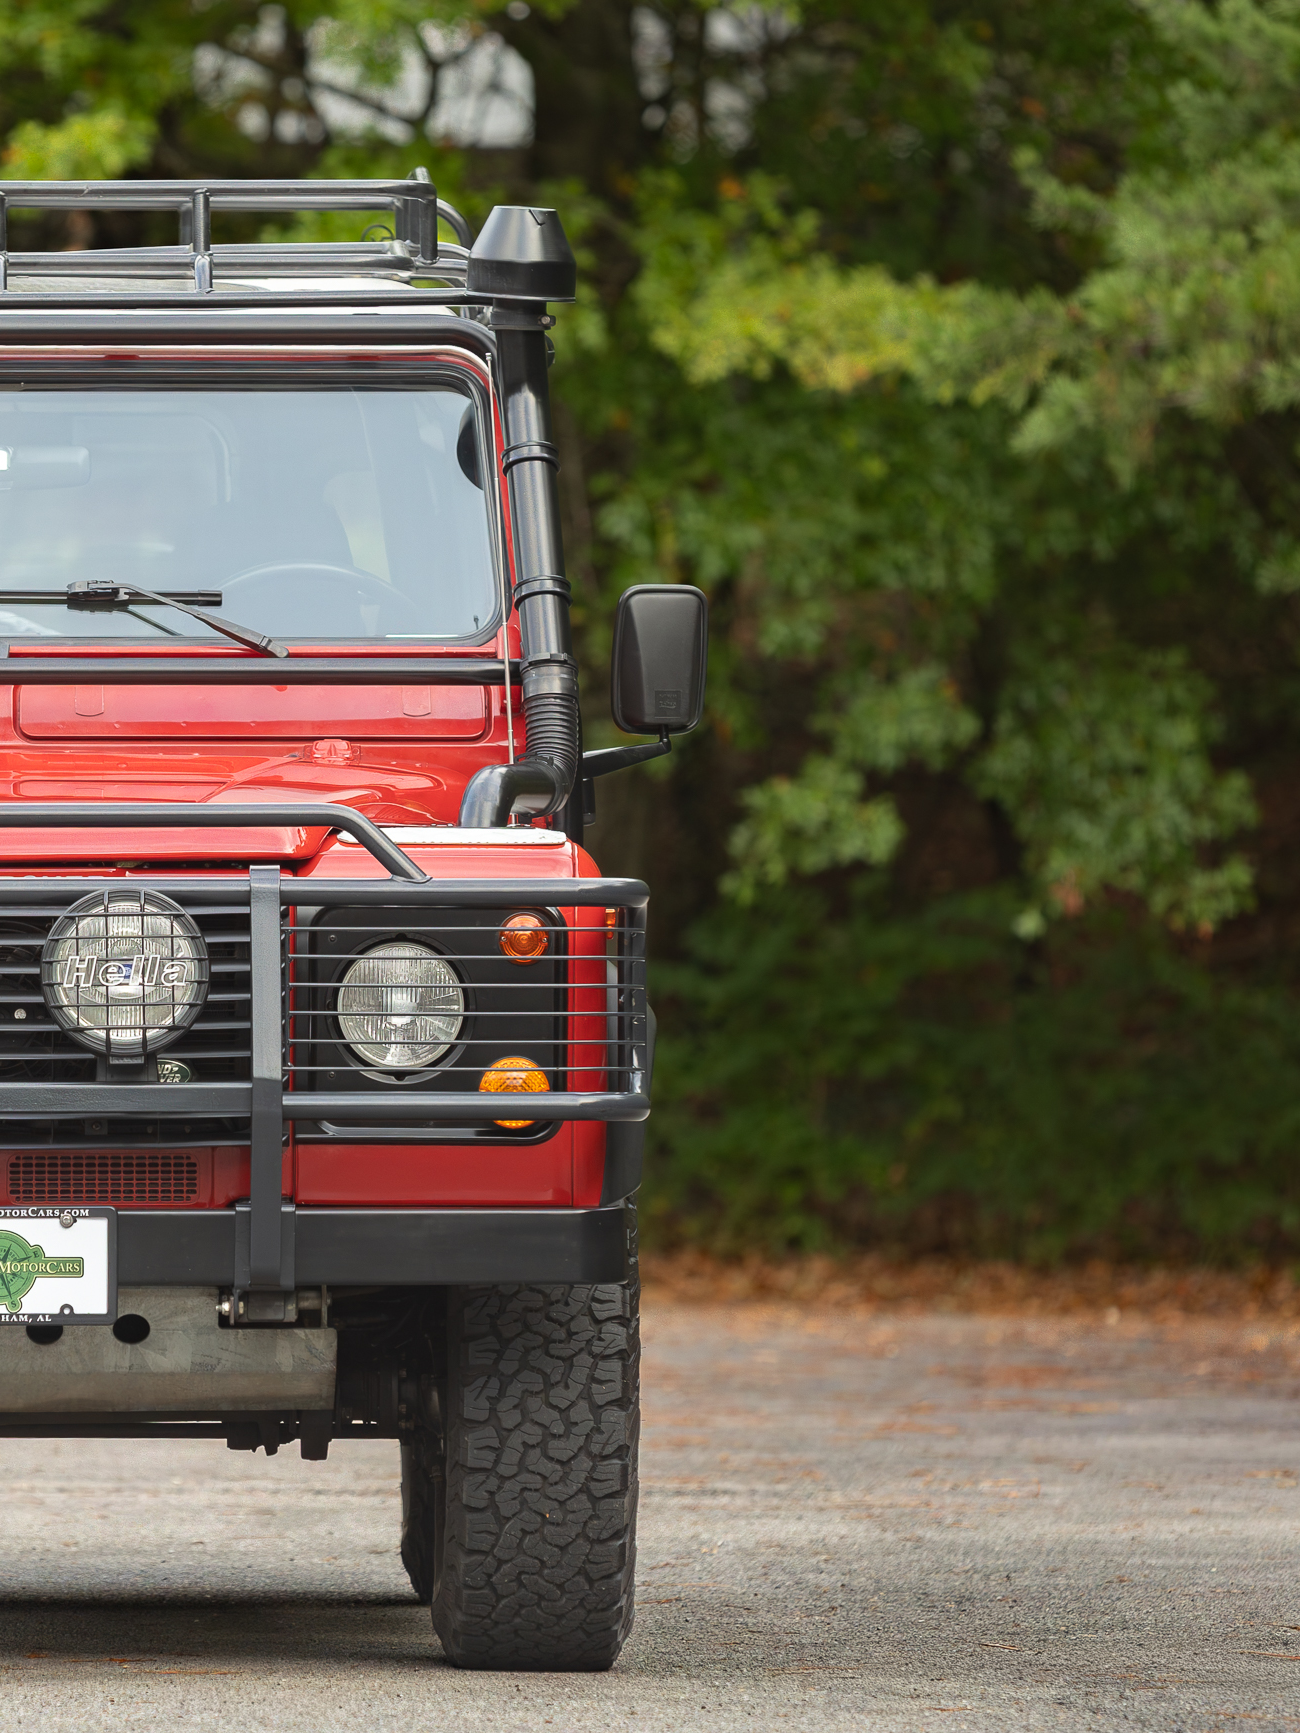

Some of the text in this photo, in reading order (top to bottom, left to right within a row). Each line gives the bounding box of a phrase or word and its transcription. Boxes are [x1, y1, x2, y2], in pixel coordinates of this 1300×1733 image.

[62, 954, 186, 987] Hella
[33, 1250, 40, 1259] E
[10, 1300, 17, 1308] S
[36, 1314, 52, 1322] AL
